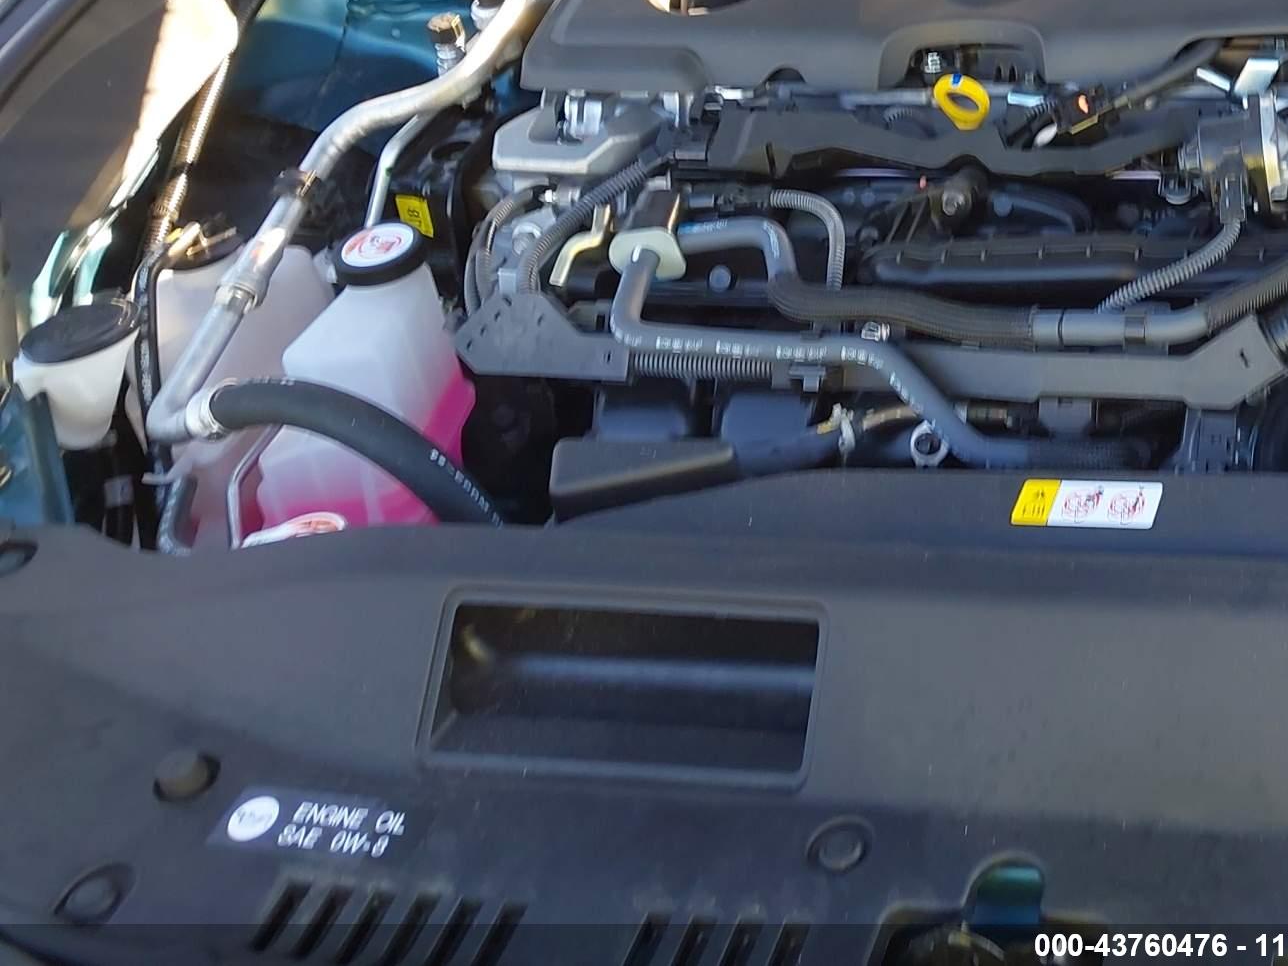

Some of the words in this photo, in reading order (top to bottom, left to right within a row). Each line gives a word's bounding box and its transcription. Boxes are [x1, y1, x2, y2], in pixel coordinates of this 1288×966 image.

[292, 801, 369, 830] ENGINE
[375, 810, 406, 836] OIL
[277, 823, 323, 850] SAE
